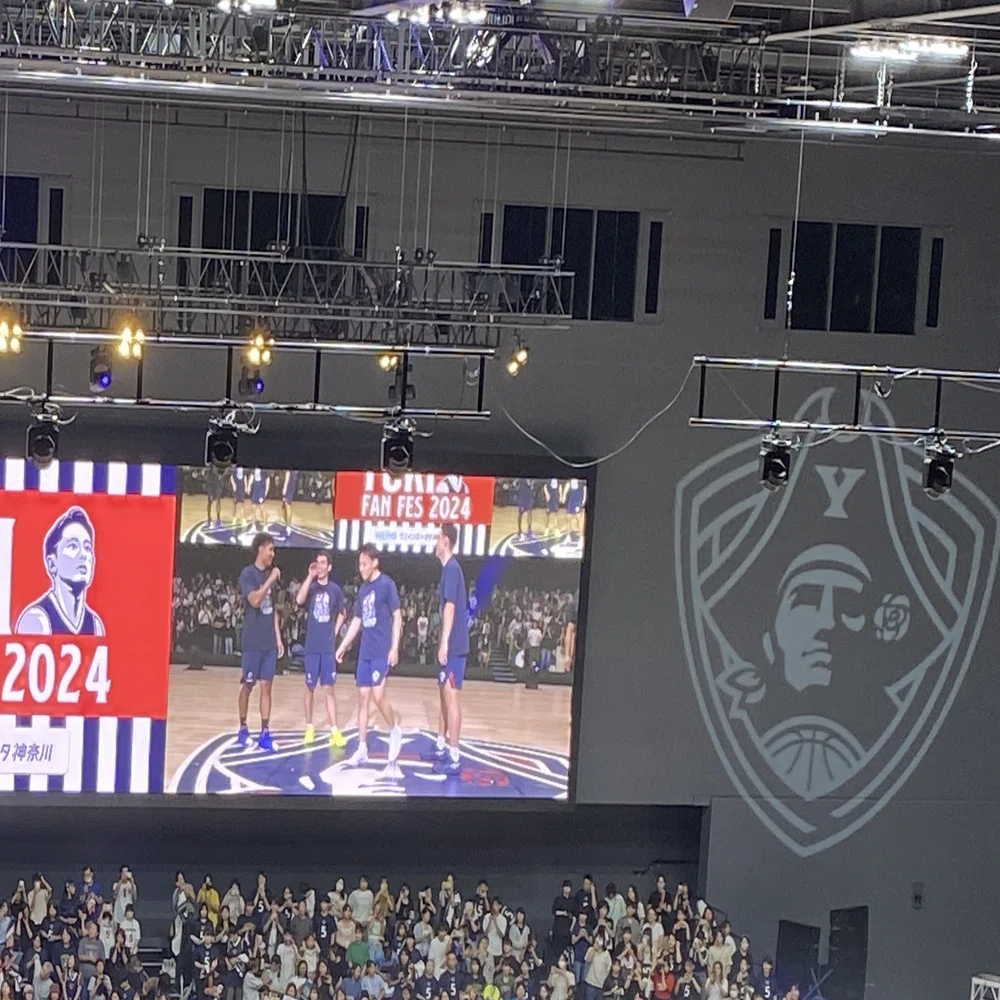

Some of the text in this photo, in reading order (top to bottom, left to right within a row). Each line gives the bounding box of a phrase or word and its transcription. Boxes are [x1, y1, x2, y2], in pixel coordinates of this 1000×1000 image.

[361, 494, 471, 520] FAN FES 2024
[815, 465, 866, 519] Y
[1, 642, 112, 703] 2024
[764, 985, 771, 998] 5
